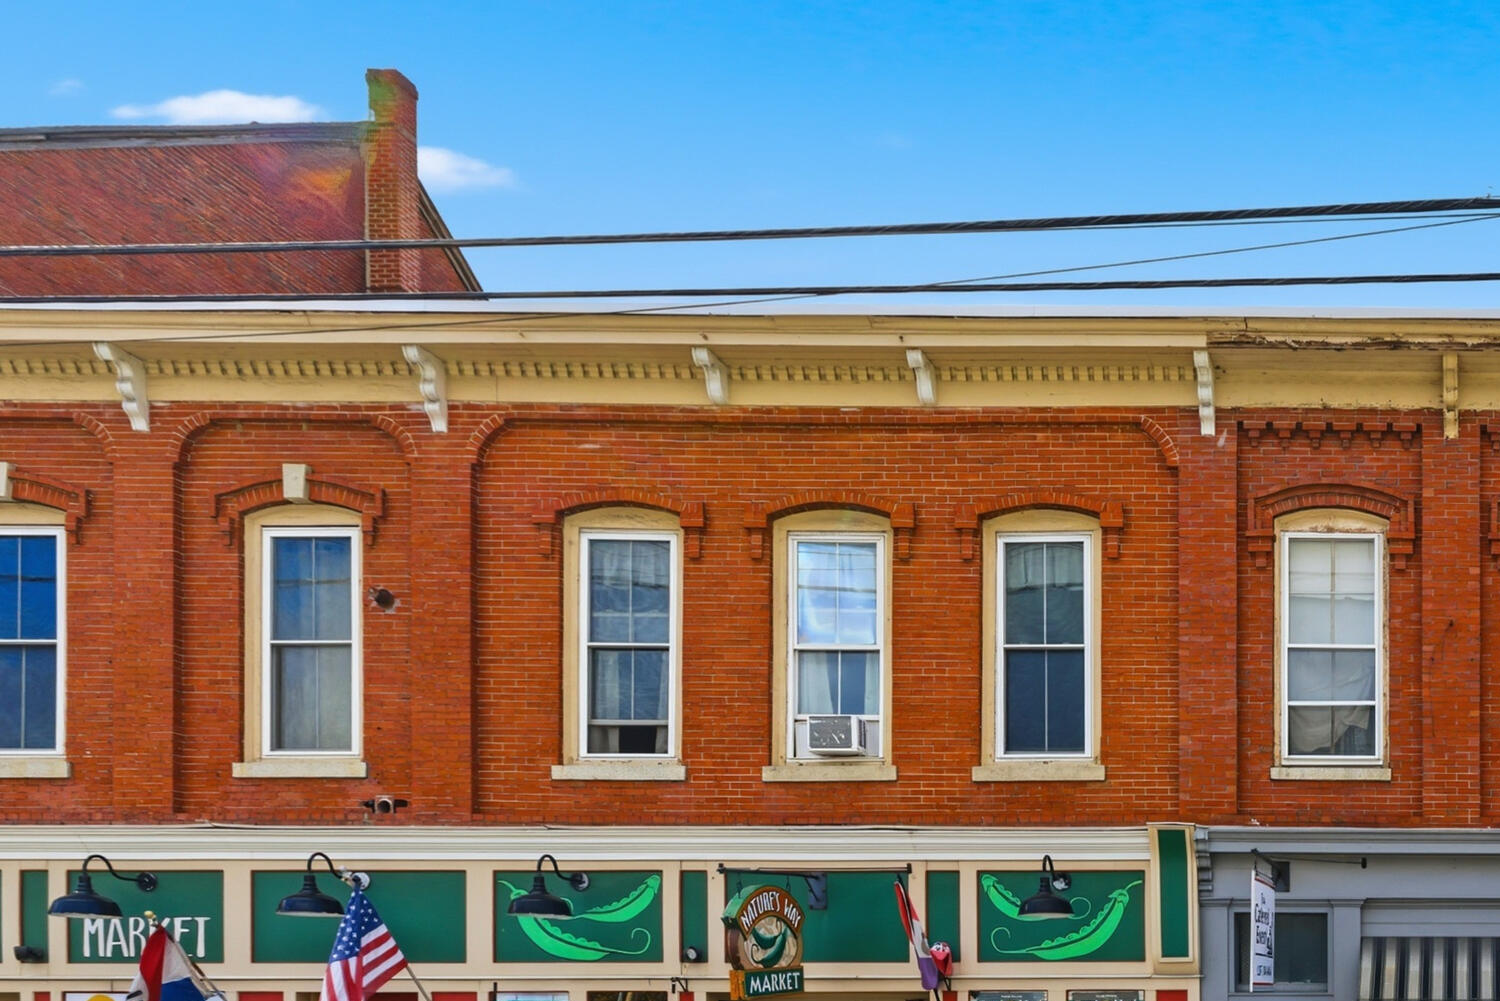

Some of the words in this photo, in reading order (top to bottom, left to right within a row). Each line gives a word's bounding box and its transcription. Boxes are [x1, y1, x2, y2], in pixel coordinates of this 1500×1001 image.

[741, 891, 780, 932] NATURE'S
[784, 898, 802, 928] WAY
[749, 972, 800, 994] MARKET
